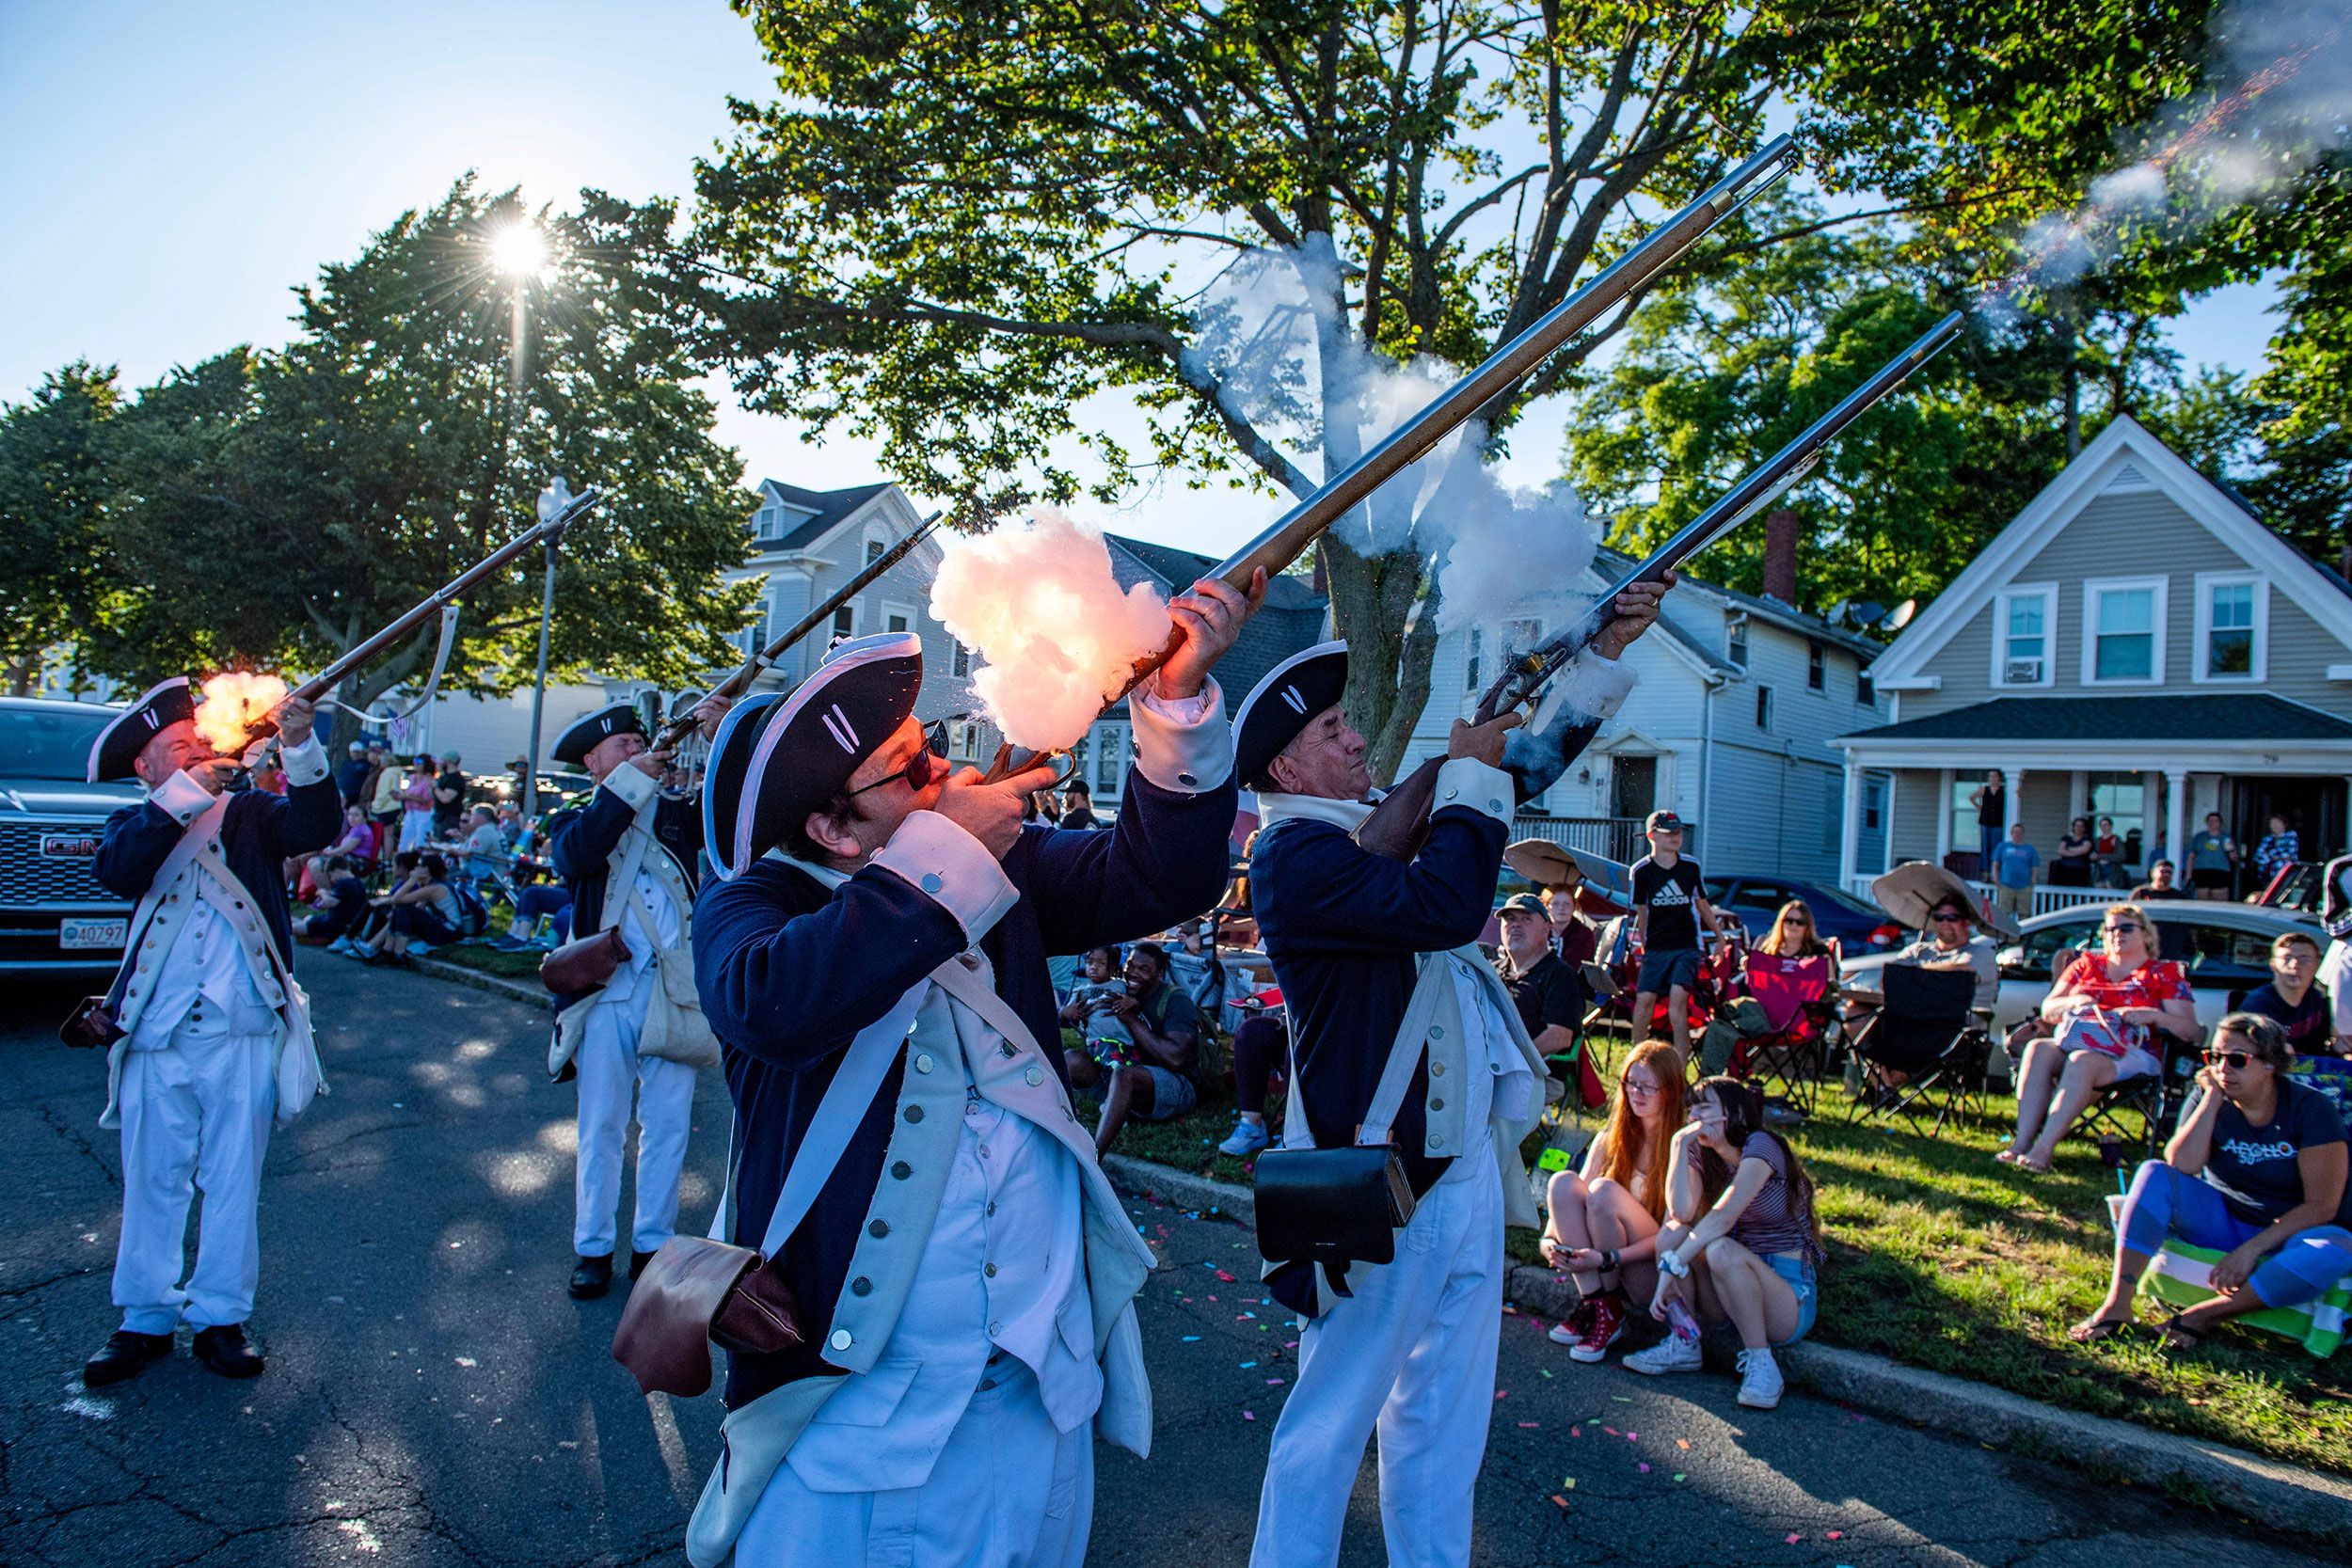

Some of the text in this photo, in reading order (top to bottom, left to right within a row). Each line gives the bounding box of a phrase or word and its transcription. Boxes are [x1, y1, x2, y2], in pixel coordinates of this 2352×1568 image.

[46, 837, 98, 855] GM
[1651, 895, 1690, 907] adidas
[78, 926, 123, 942] 40797
